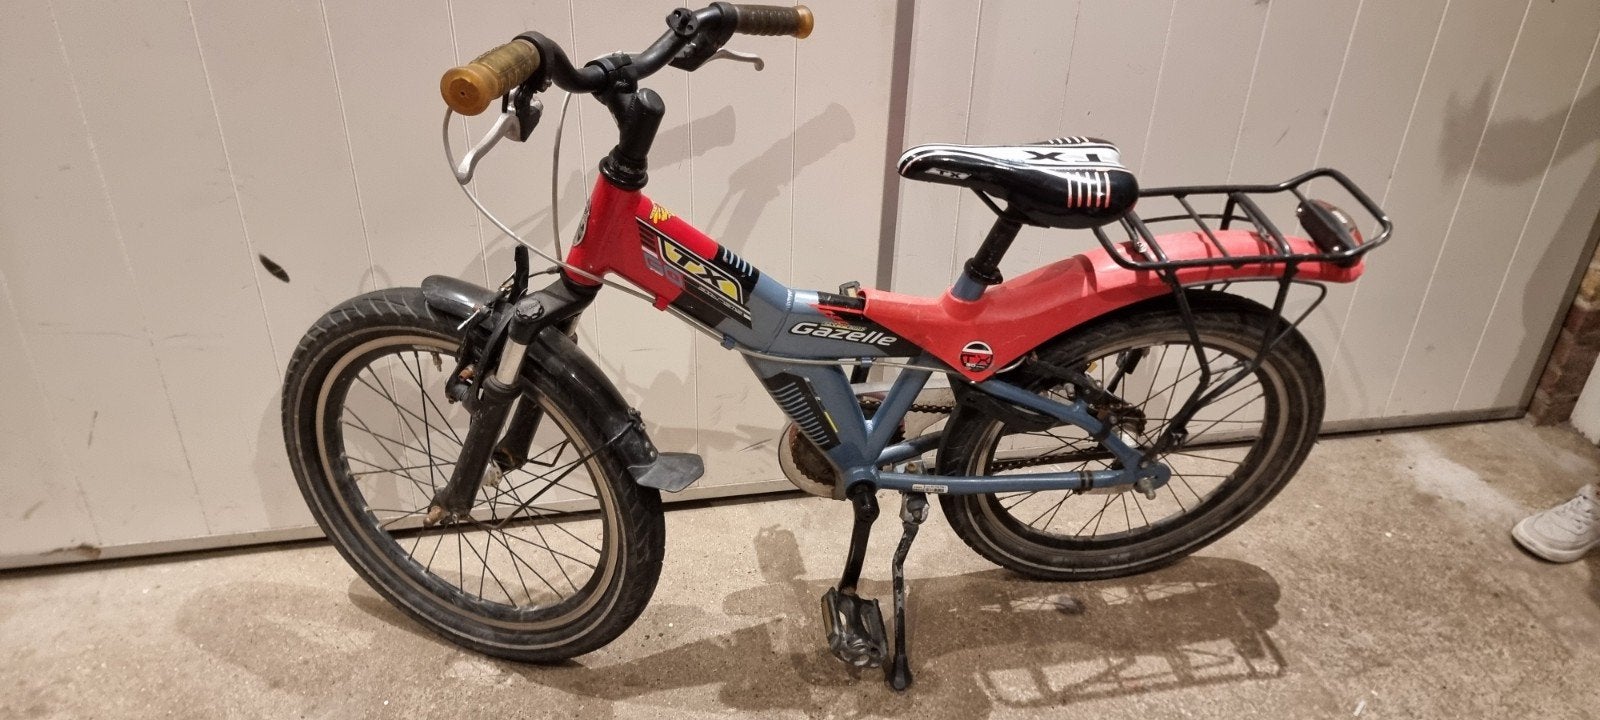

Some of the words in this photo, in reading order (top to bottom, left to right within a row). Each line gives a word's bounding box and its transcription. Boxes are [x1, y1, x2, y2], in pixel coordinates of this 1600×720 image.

[672, 248, 728, 290] TX
[791, 321, 898, 347] Gazelle
[962, 353, 992, 366] TX
